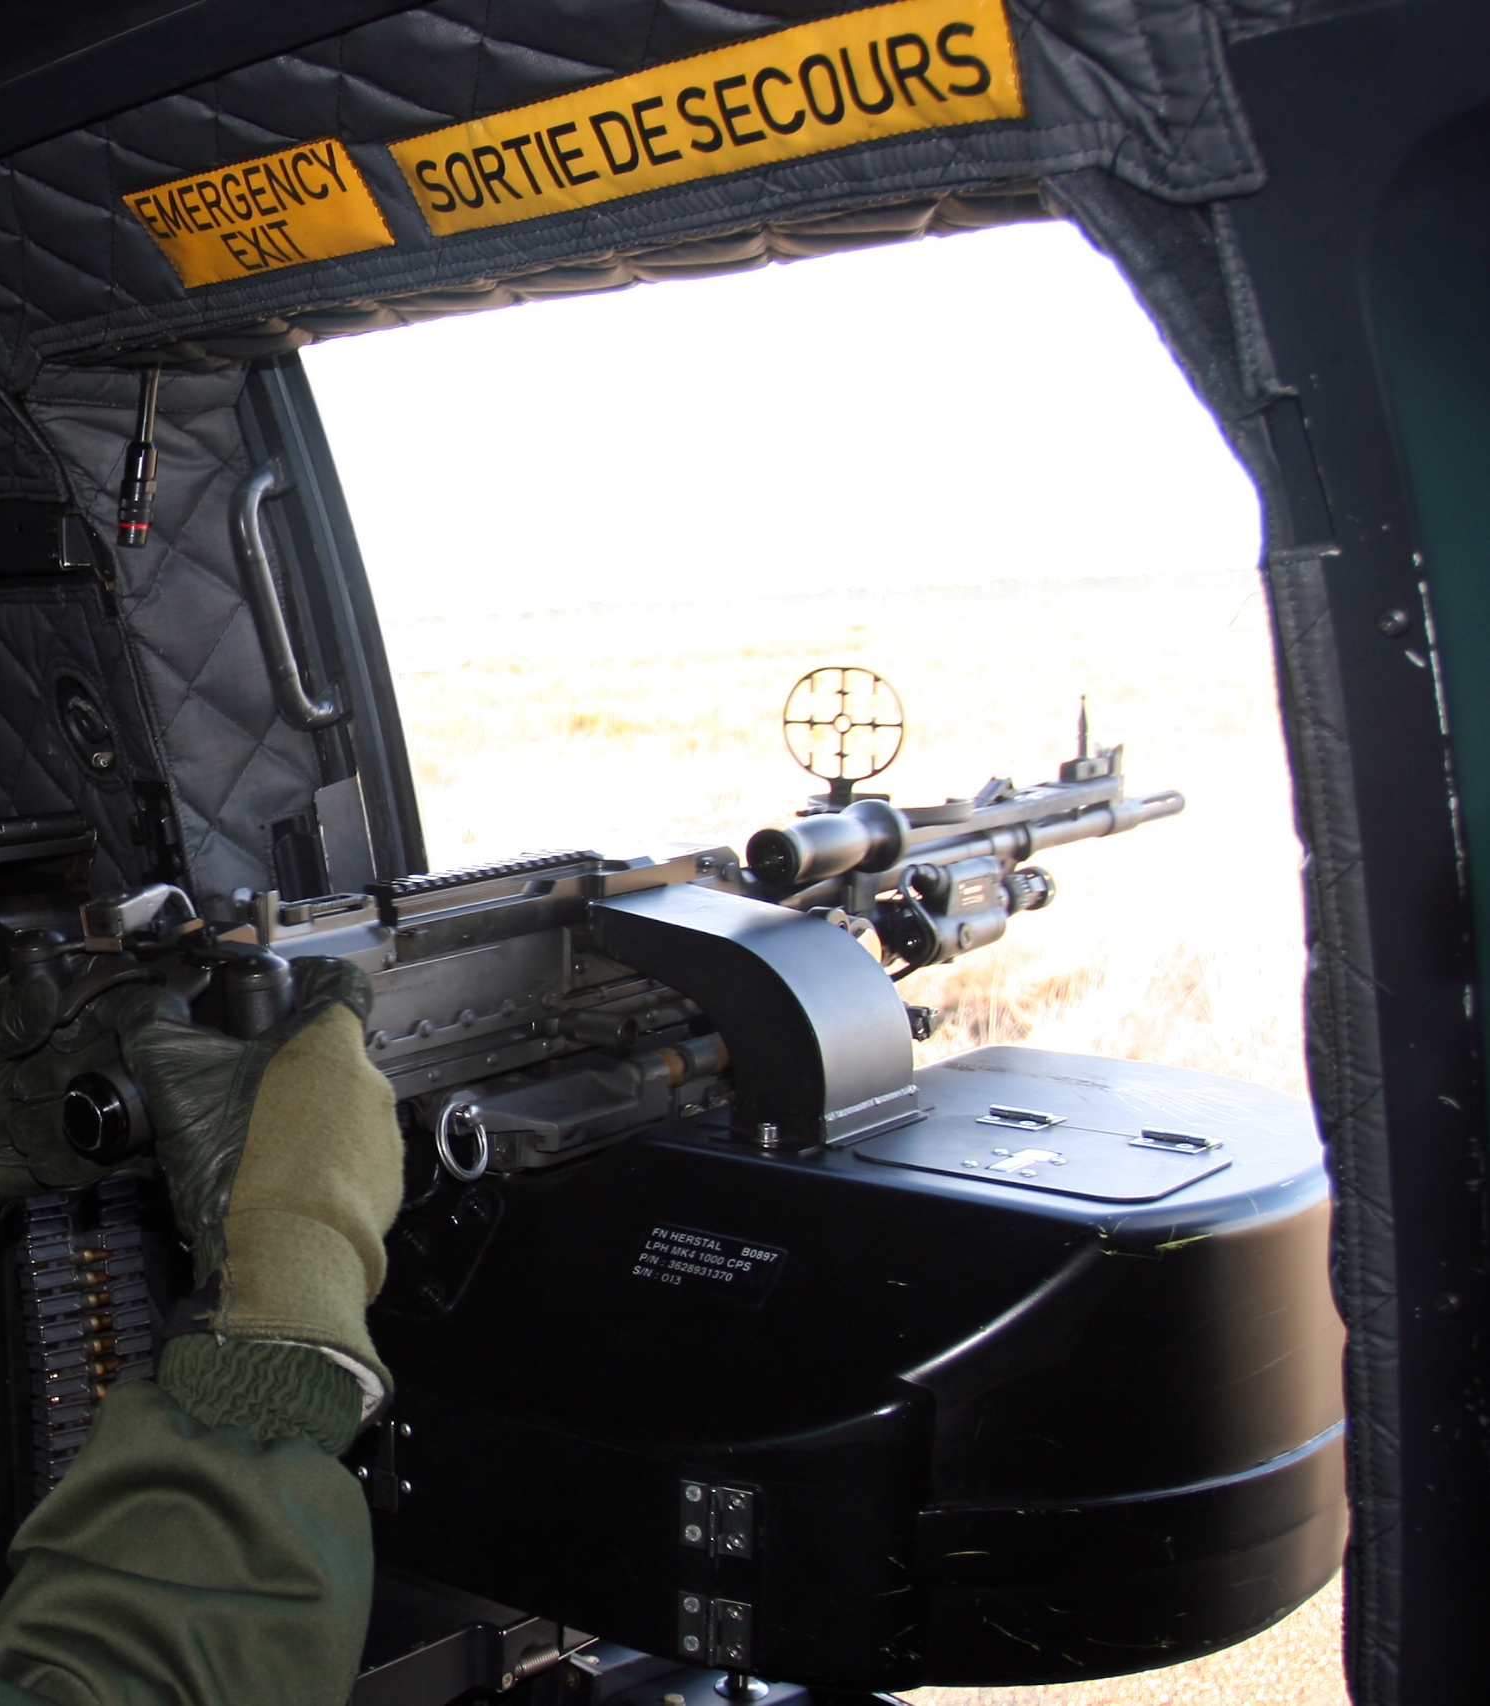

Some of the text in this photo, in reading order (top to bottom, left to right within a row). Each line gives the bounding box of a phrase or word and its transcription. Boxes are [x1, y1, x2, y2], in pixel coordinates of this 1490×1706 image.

[414, 21, 991, 213] SORTIE DE SECOURS
[133, 142, 349, 238] EMERGENCY
[219, 219, 307, 271] EXIT
[645, 1240, 753, 1272] LPH MK4 1000 CPS
[651, 1227, 779, 1262] FN HERSTAL B0897
[632, 1265, 653, 1278] S/N
[638, 1252, 660, 1265] P/N
[667, 1259, 734, 1282] 3628931370
